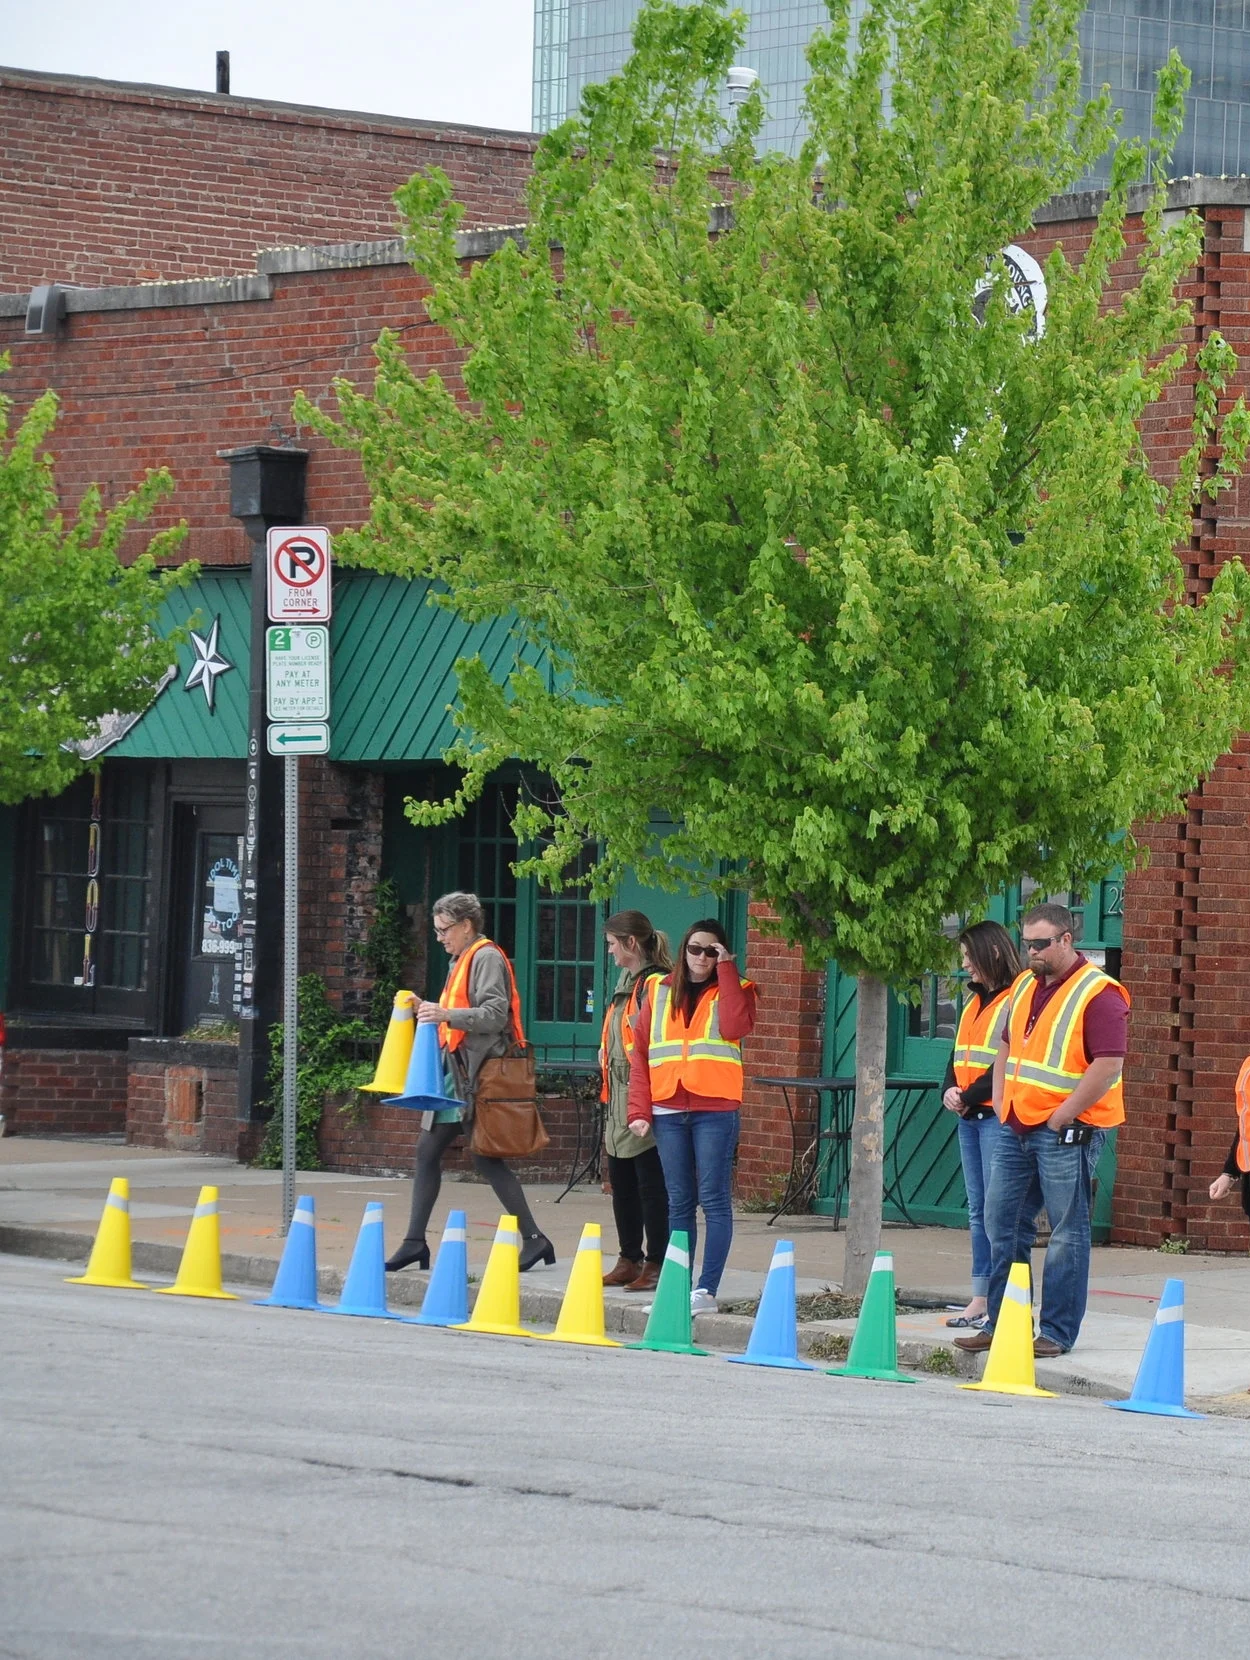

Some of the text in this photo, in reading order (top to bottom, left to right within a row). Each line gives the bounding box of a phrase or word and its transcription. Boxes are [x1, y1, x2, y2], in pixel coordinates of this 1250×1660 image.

[288, 588, 312, 597] FROM
[283, 598, 318, 607] CORNER
[274, 630, 285, 645] 2
[285, 670, 311, 678] PAY AT
[276, 679, 320, 687] ANY METER
[273, 697, 316, 705] PAY BY APP
